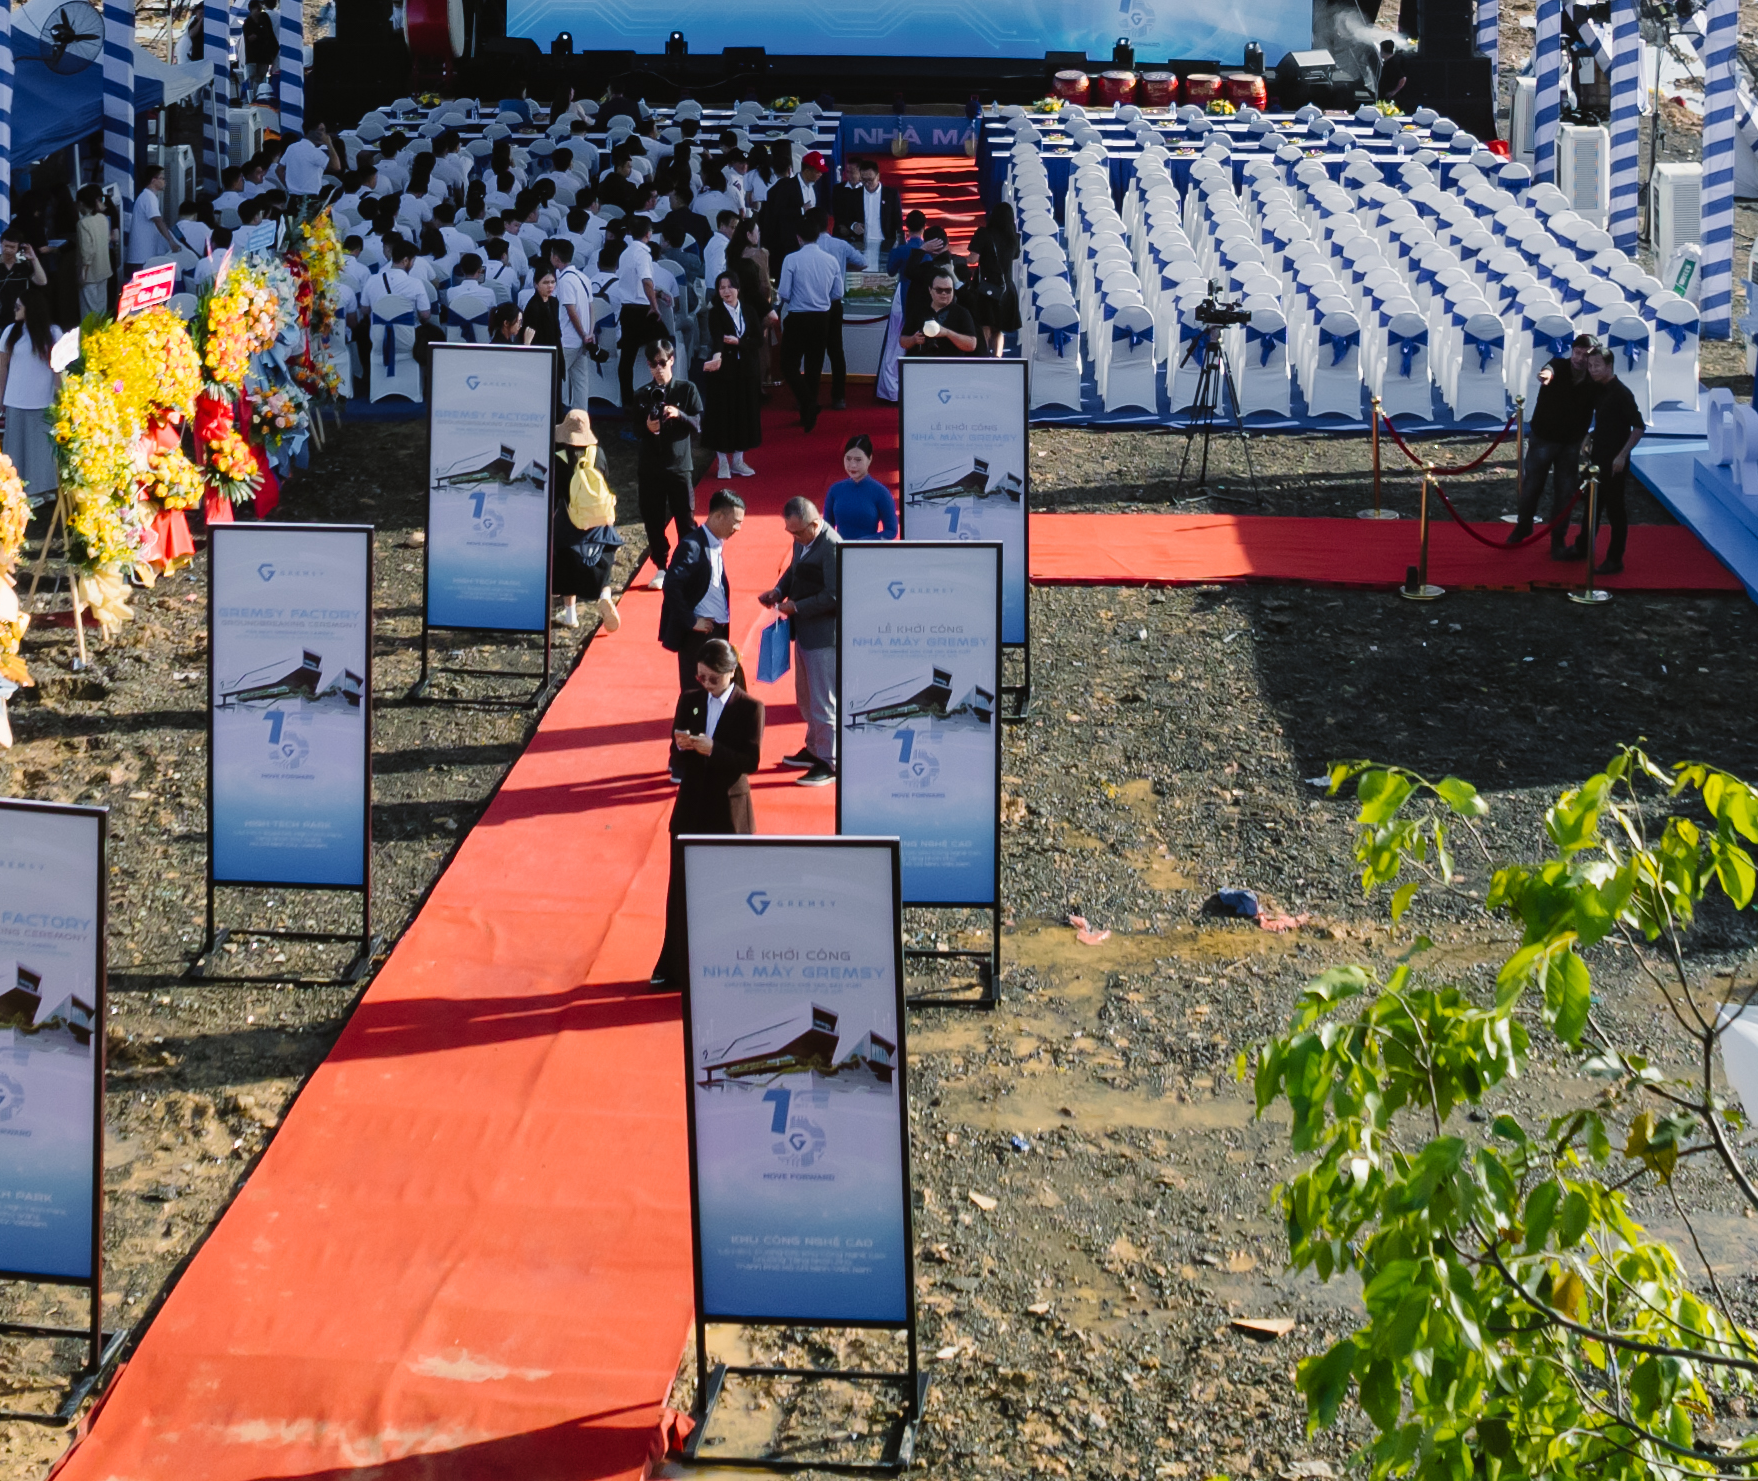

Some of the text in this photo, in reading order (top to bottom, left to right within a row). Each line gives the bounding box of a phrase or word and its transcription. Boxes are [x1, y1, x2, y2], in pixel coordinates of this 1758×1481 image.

[853, 124, 922, 146] NHÀ
[969, 434, 1017, 442] GREMSY
[218, 607, 361, 620] GREMSY FACTORY
[926, 637, 988, 647] GREMSY
[776, 899, 838, 908] GREMSY
[2, 910, 93, 932] FACTORY
[23, 927, 88, 942] CEREMONY
[736, 946, 851, 962] LỄ KHỞI CÔNG
[702, 962, 885, 980] NHÀ MÁY GREMSY
[762, 1172, 836, 1183] MOVE FORWARD
[16, 1190, 53, 1203] PARK
